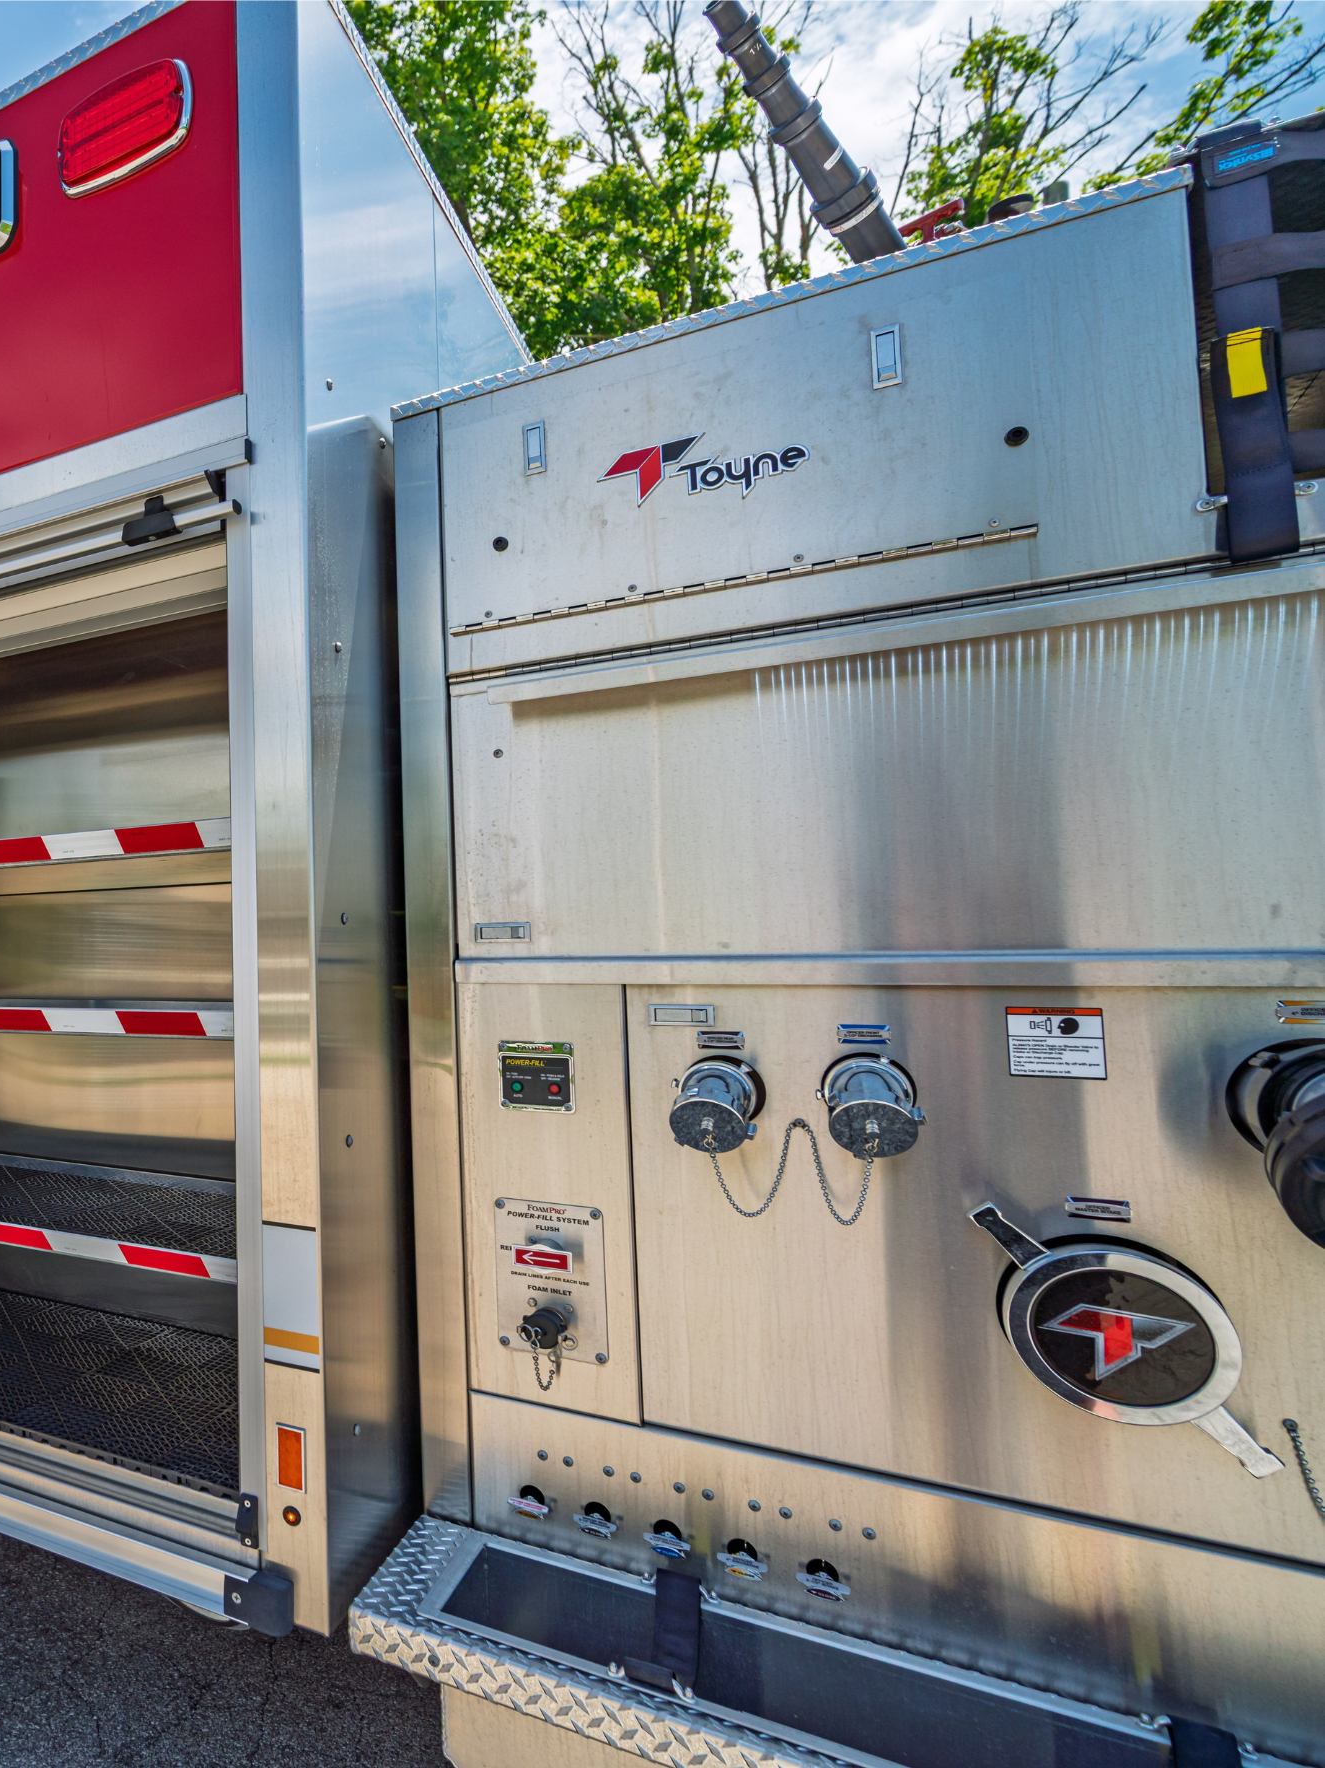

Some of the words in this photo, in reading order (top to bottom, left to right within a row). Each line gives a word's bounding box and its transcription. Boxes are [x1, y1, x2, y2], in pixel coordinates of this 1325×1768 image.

[671, 444, 809, 498] Toyne
[507, 1210, 554, 1222] POWER-FILL
[556, 1216, 590, 1226] SYSTEM
[535, 1224, 560, 1233] FLUSH
[527, 1284, 549, 1293] FOAM
[550, 1287, 573, 1297] INLET
